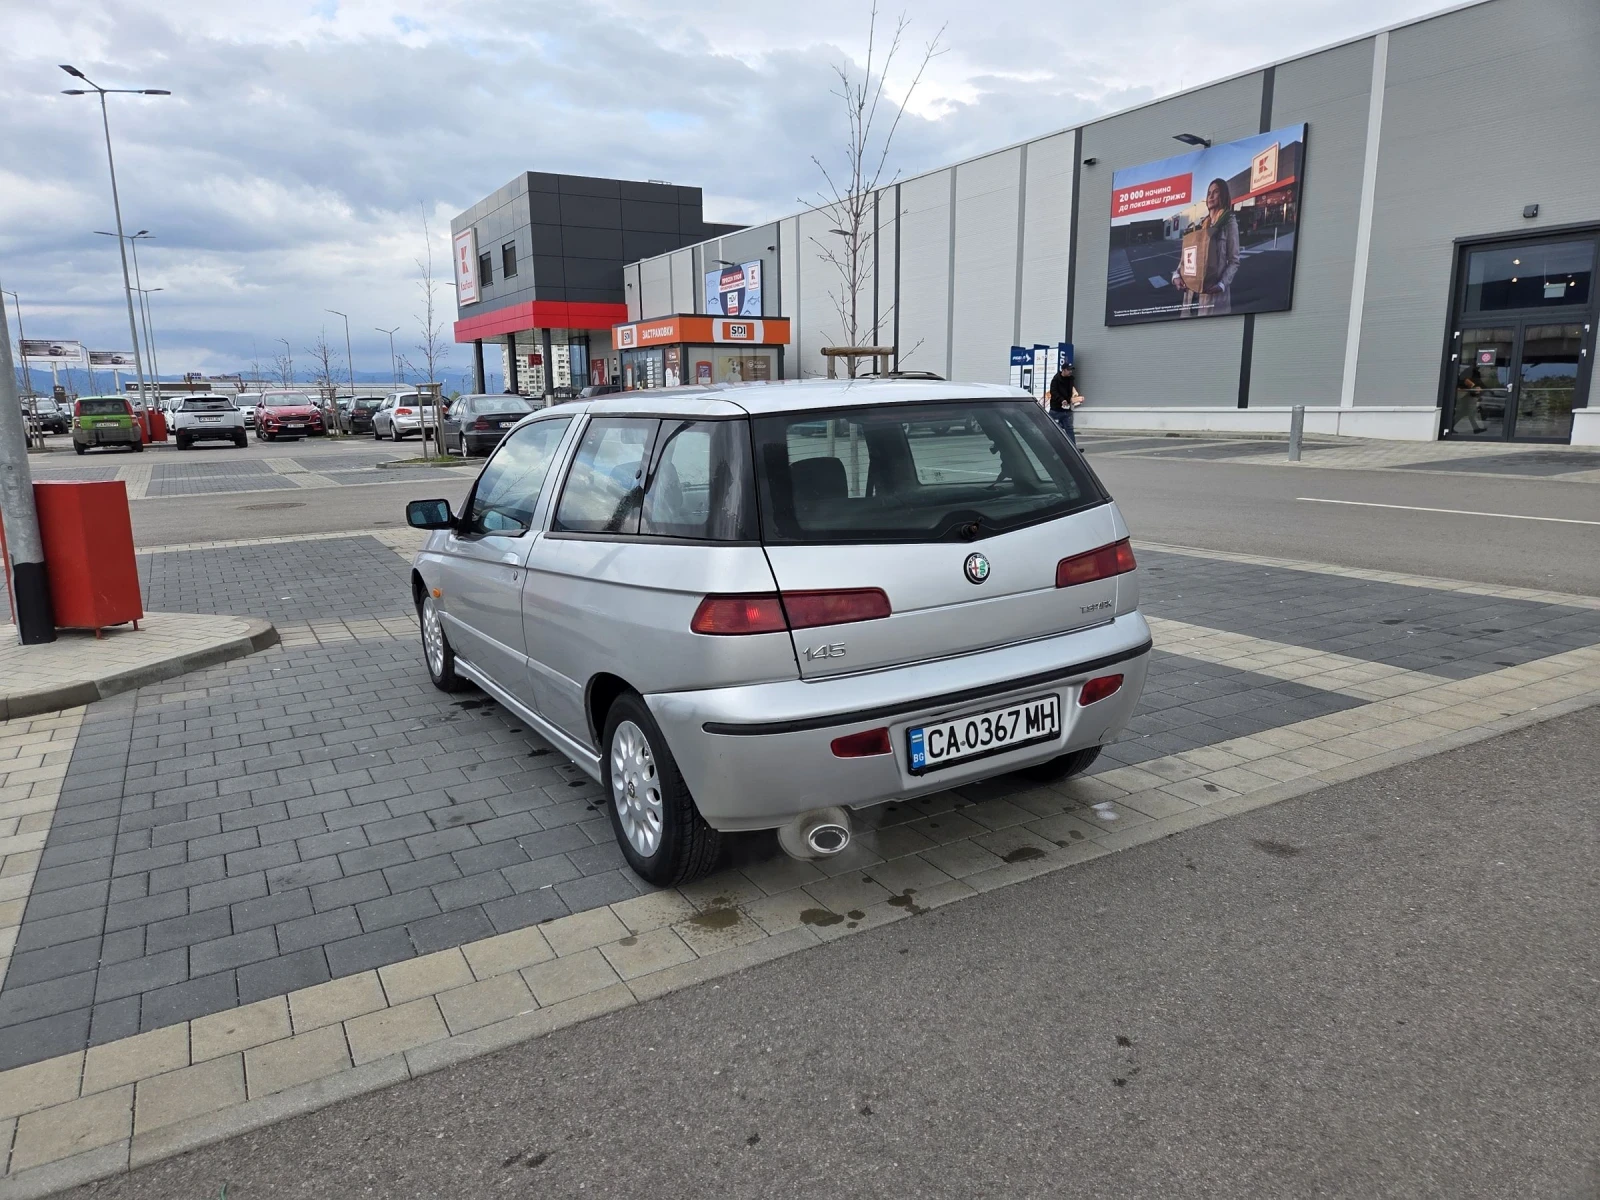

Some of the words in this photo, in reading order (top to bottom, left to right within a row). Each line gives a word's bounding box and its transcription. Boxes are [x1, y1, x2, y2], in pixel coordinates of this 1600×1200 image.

[1118, 204, 1129, 213] да
[1129, 197, 1162, 209] покажеш
[1162, 191, 1186, 204] грижа
[1119, 193, 1129, 203] 20
[1130, 190, 1144, 200] 000
[1145, 186, 1171, 197] начина
[642, 325, 674, 340] ЗАСТРАХОВКИ
[731, 326, 746, 335] SDI
[802, 642, 846, 661] 145
[913, 752, 924, 763] BG
